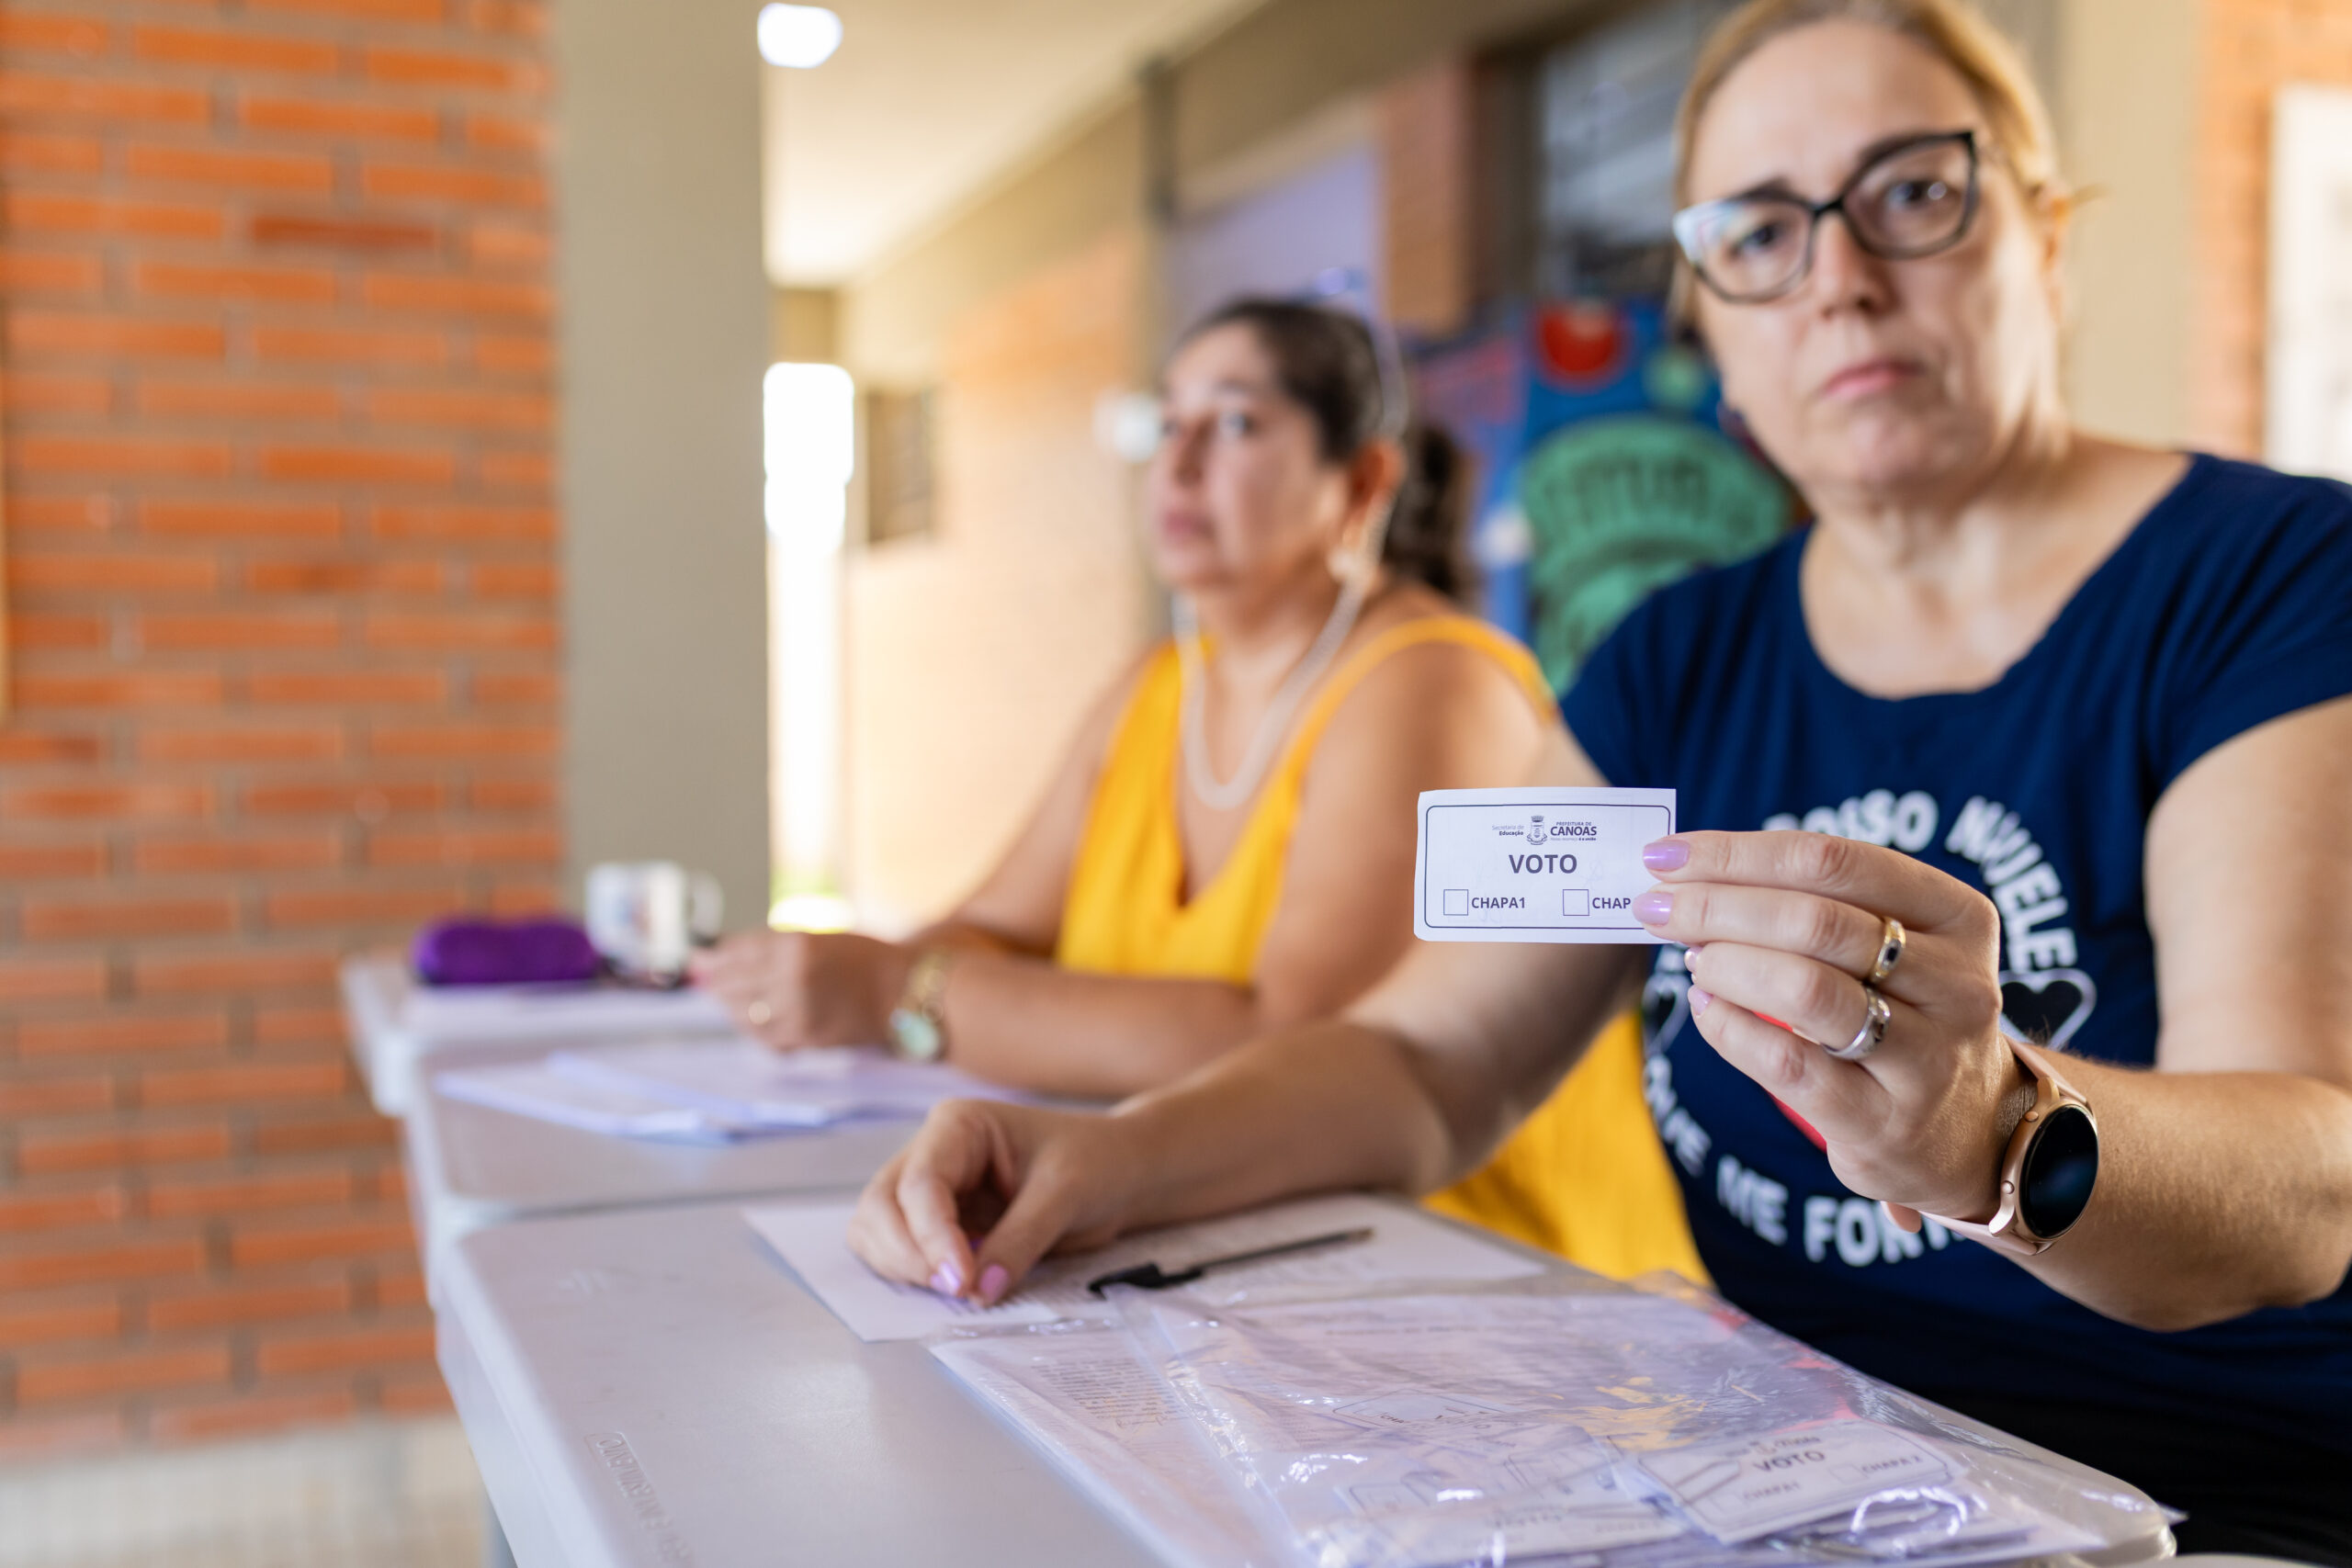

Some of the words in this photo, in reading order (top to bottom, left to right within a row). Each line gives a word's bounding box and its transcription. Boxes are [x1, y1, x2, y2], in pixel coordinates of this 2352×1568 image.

[1550, 827, 1597, 837] CANOAS
[1509, 854, 1577, 874] VOTO
[1471, 897, 1526, 909] CHAPA1
[1591, 897, 1632, 909] CHAP
[1716, 1154, 1789, 1247] ME
[1804, 1195, 1968, 1268] FOR
[1752, 1450, 1826, 1472] VOTO
